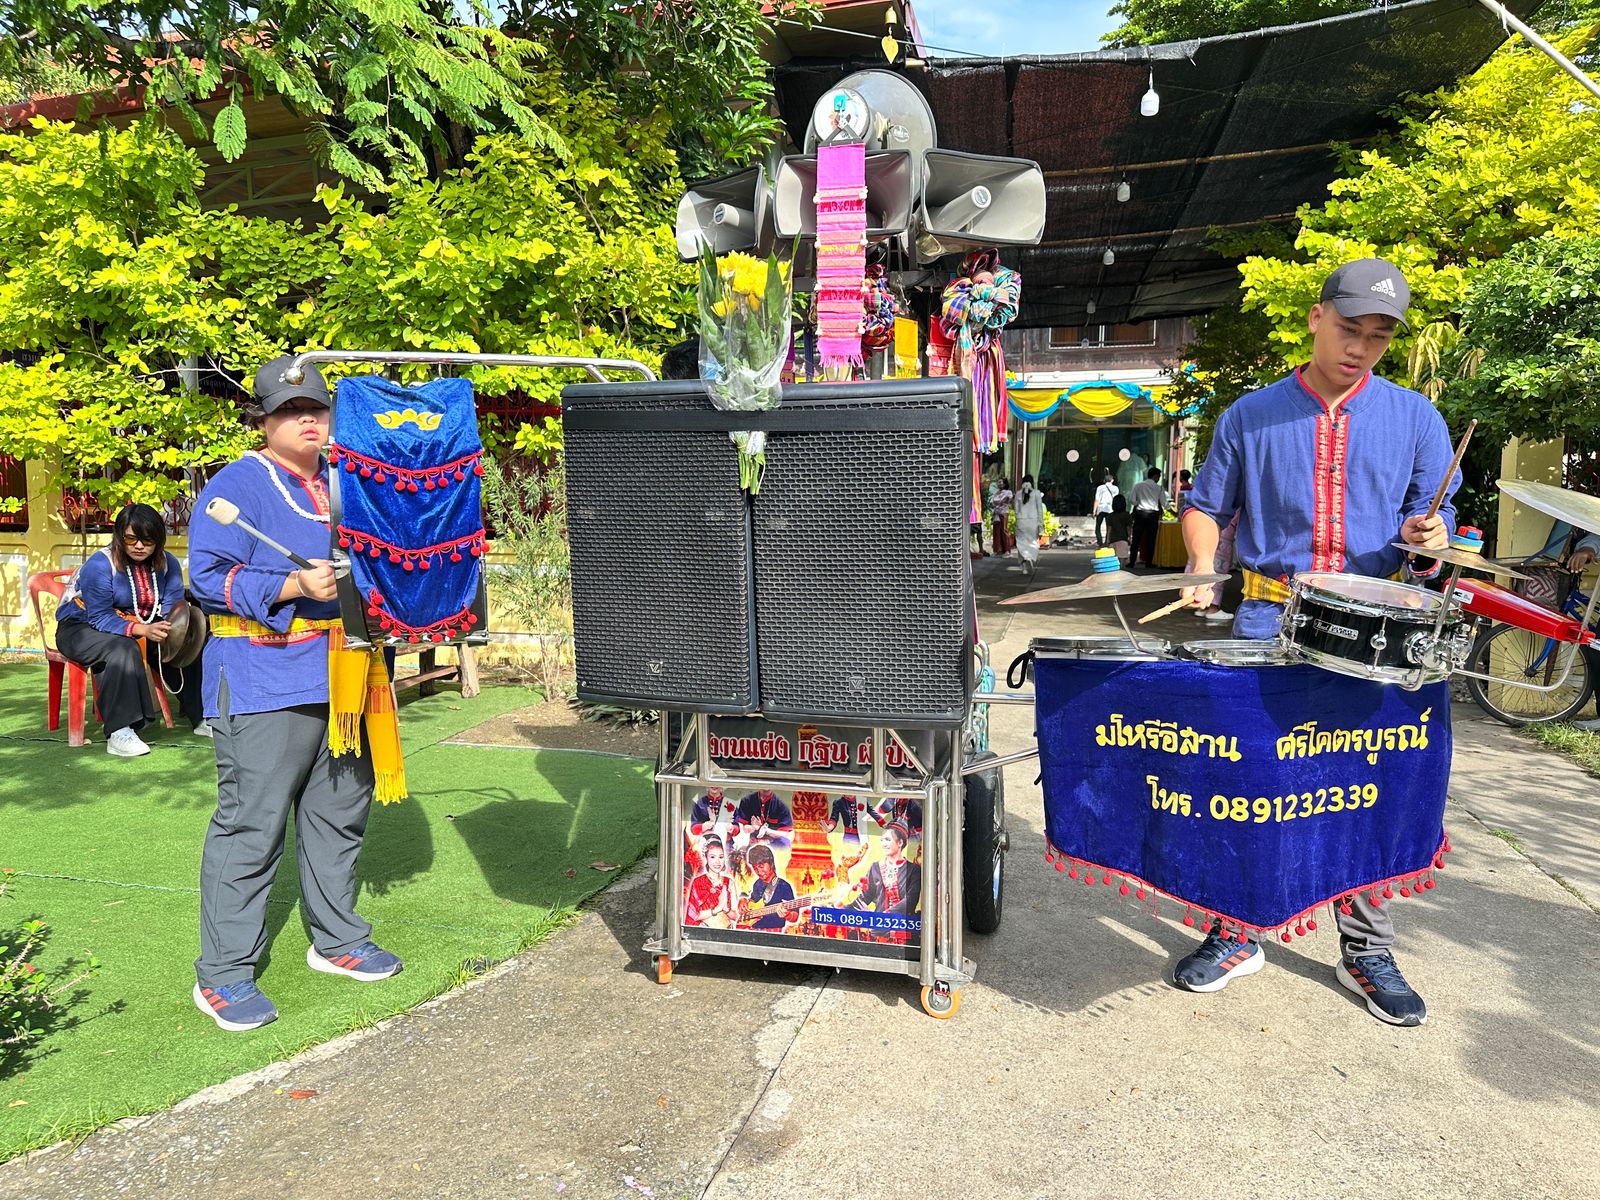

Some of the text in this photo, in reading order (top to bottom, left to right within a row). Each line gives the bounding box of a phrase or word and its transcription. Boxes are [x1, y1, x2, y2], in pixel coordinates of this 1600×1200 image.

[1370, 283, 1396, 298] adidas
[798, 735, 849, 768] กฐิน
[1095, 707, 1432, 765] มโหรีอีสาน ศรีโคตรบูรณ์
[1147, 775, 1379, 823] โทร. 0891232339
[814, 908, 922, 930] โทร. 089-1232339
